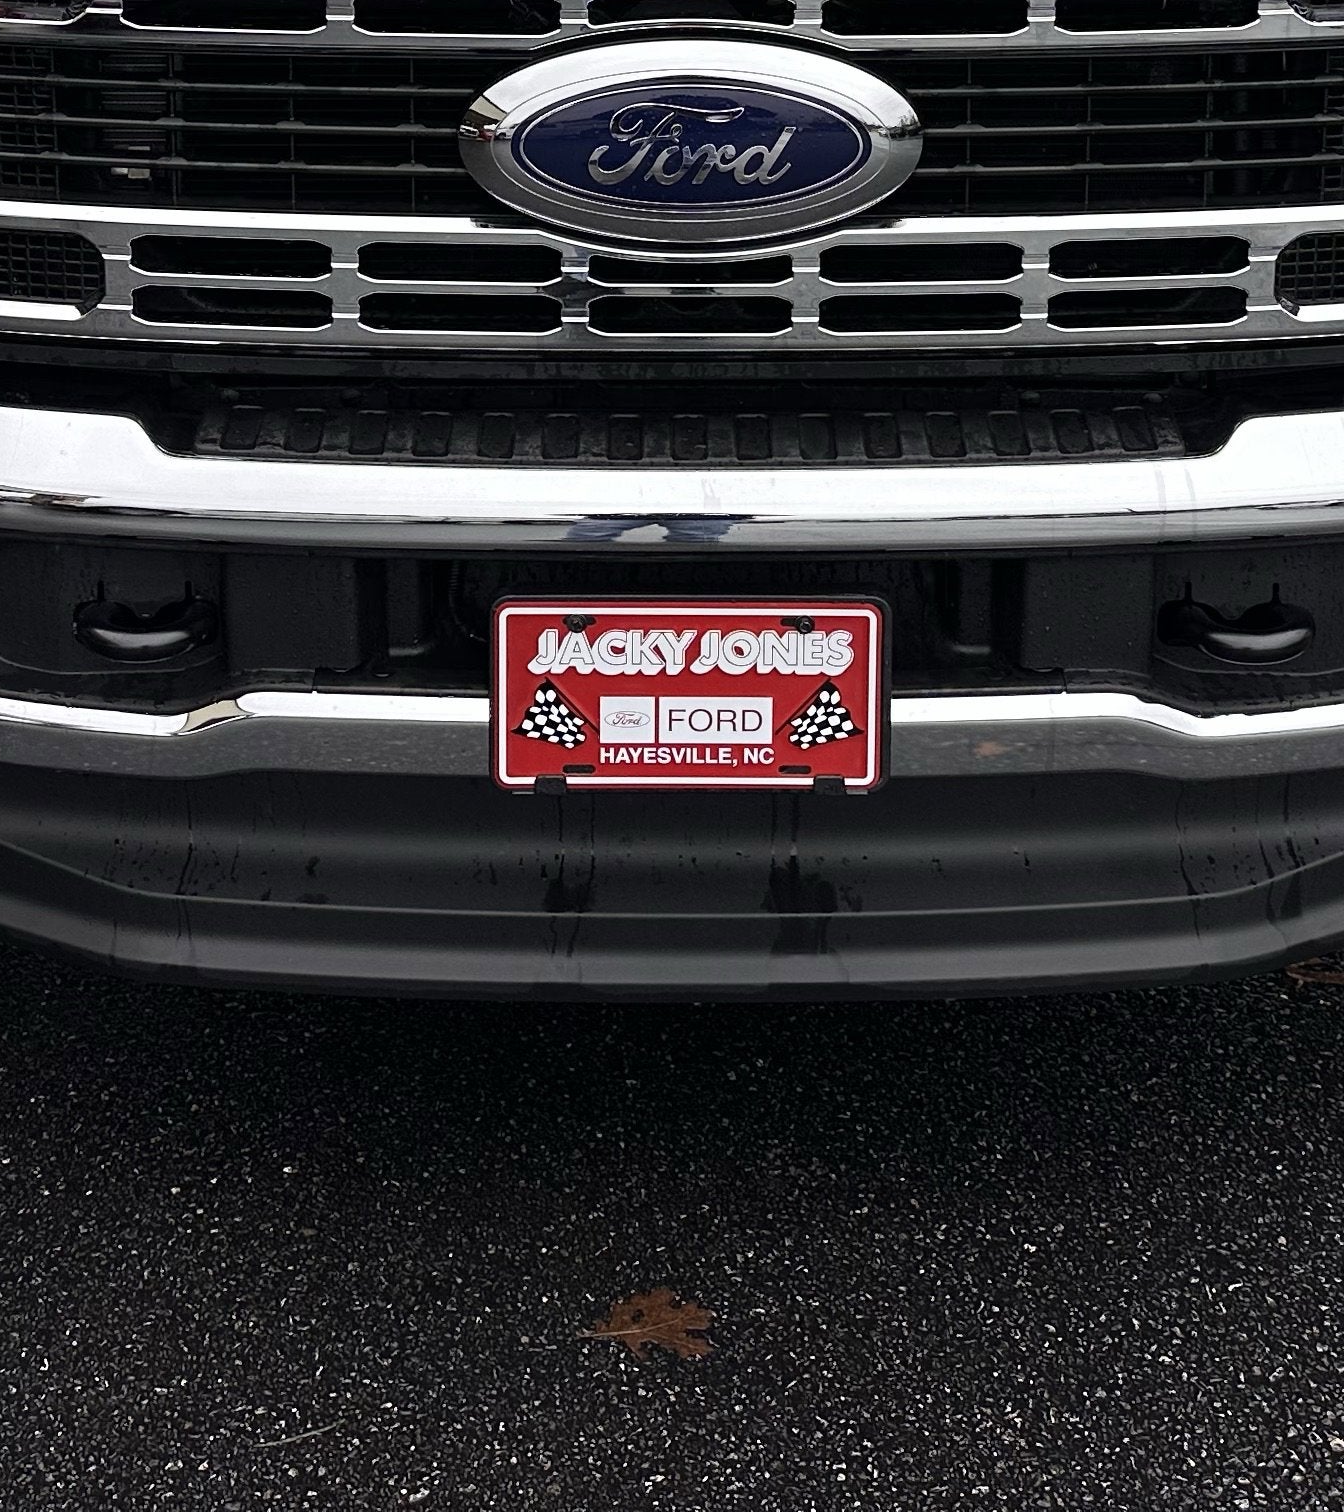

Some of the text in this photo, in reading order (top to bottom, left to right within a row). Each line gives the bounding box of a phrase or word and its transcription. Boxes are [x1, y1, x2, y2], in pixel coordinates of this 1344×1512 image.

[588, 102, 797, 186] Ford
[528, 629, 855, 676] JACKY JONES
[612, 708, 763, 732] Ford FORD
[599, 747, 775, 767] HAYESVILLE, NC
